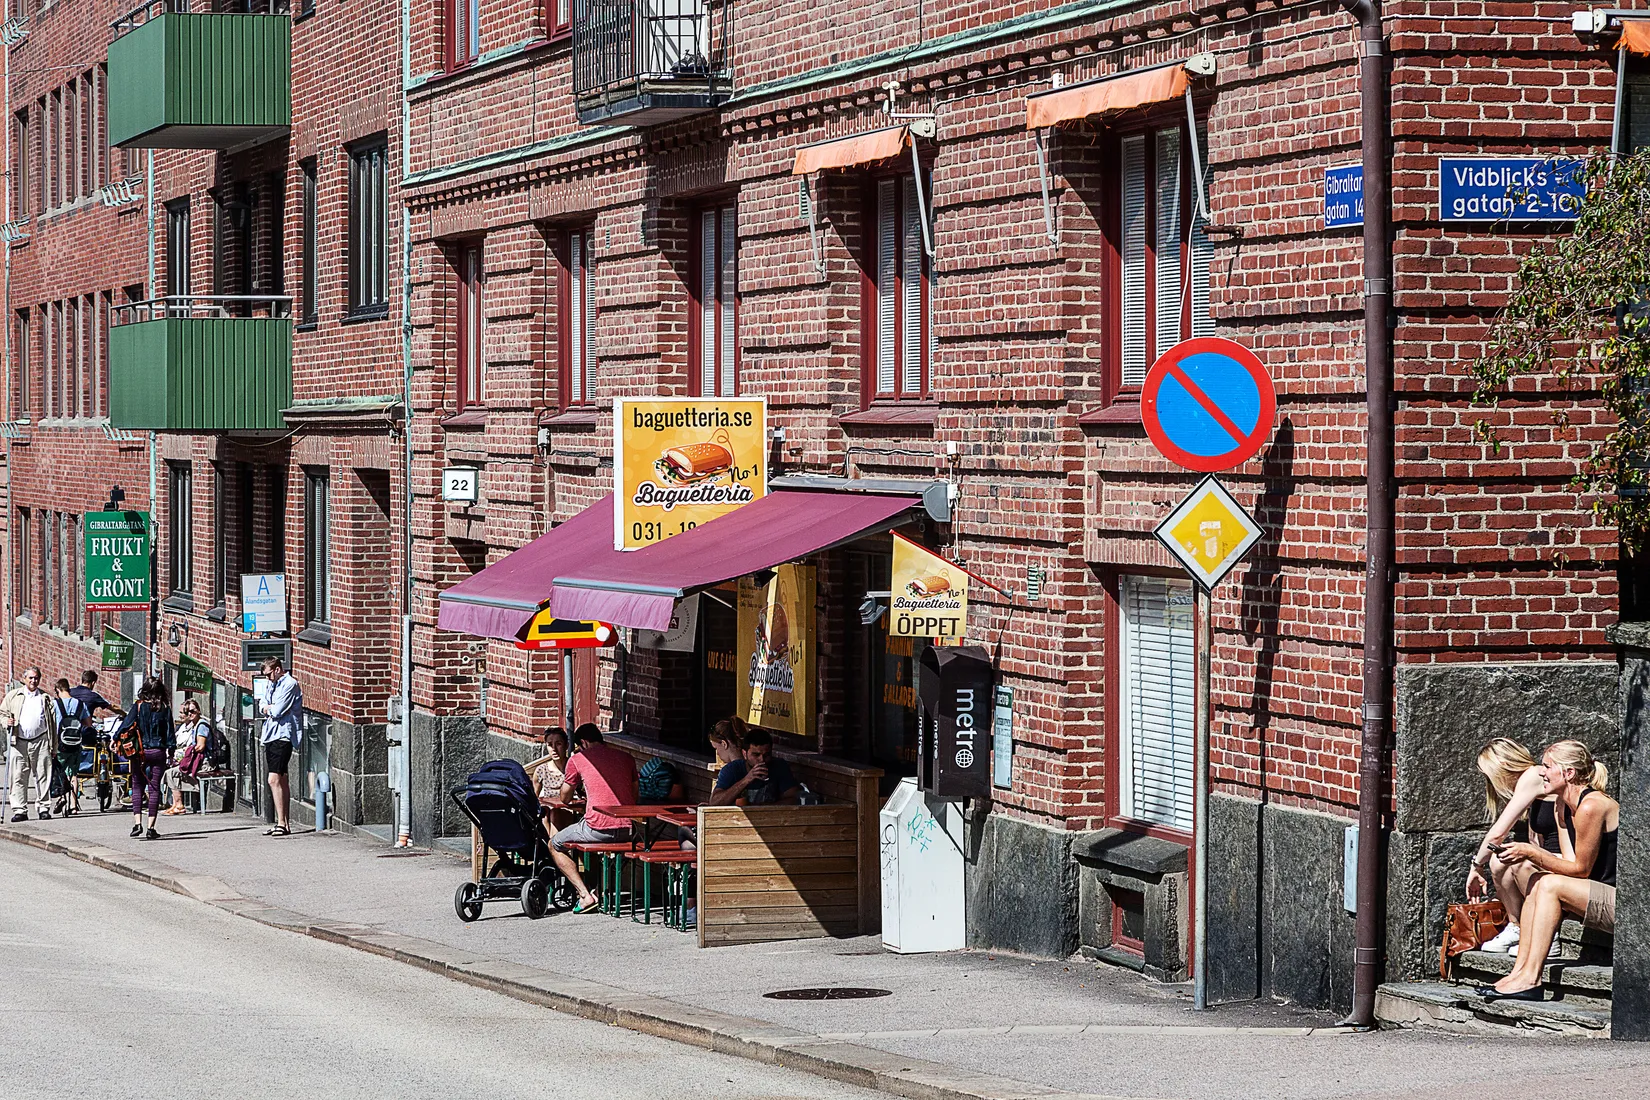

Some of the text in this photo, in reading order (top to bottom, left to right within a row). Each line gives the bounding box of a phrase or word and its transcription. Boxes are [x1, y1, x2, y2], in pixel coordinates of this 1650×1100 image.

[1326, 173, 1362, 194] Gibraltar
[1326, 200, 1350, 224] gatan
[1453, 193, 1515, 217] gatan
[633, 407, 752, 431] baguetteria.se
[728, 464, 758, 482] No 1
[451, 479, 469, 491] 22
[635, 483, 754, 509] Baguetteria
[89, 520, 146, 530] GIBRALTARGATANS
[633, 521, 662, 541] 031
[91, 536, 144, 556] FRUKT
[111, 557, 124, 572] &
[90, 574, 145, 598] GRÖNT
[257, 575, 270, 596] A
[894, 596, 961, 612] Baguetteria
[897, 613, 961, 636] ÖPPET
